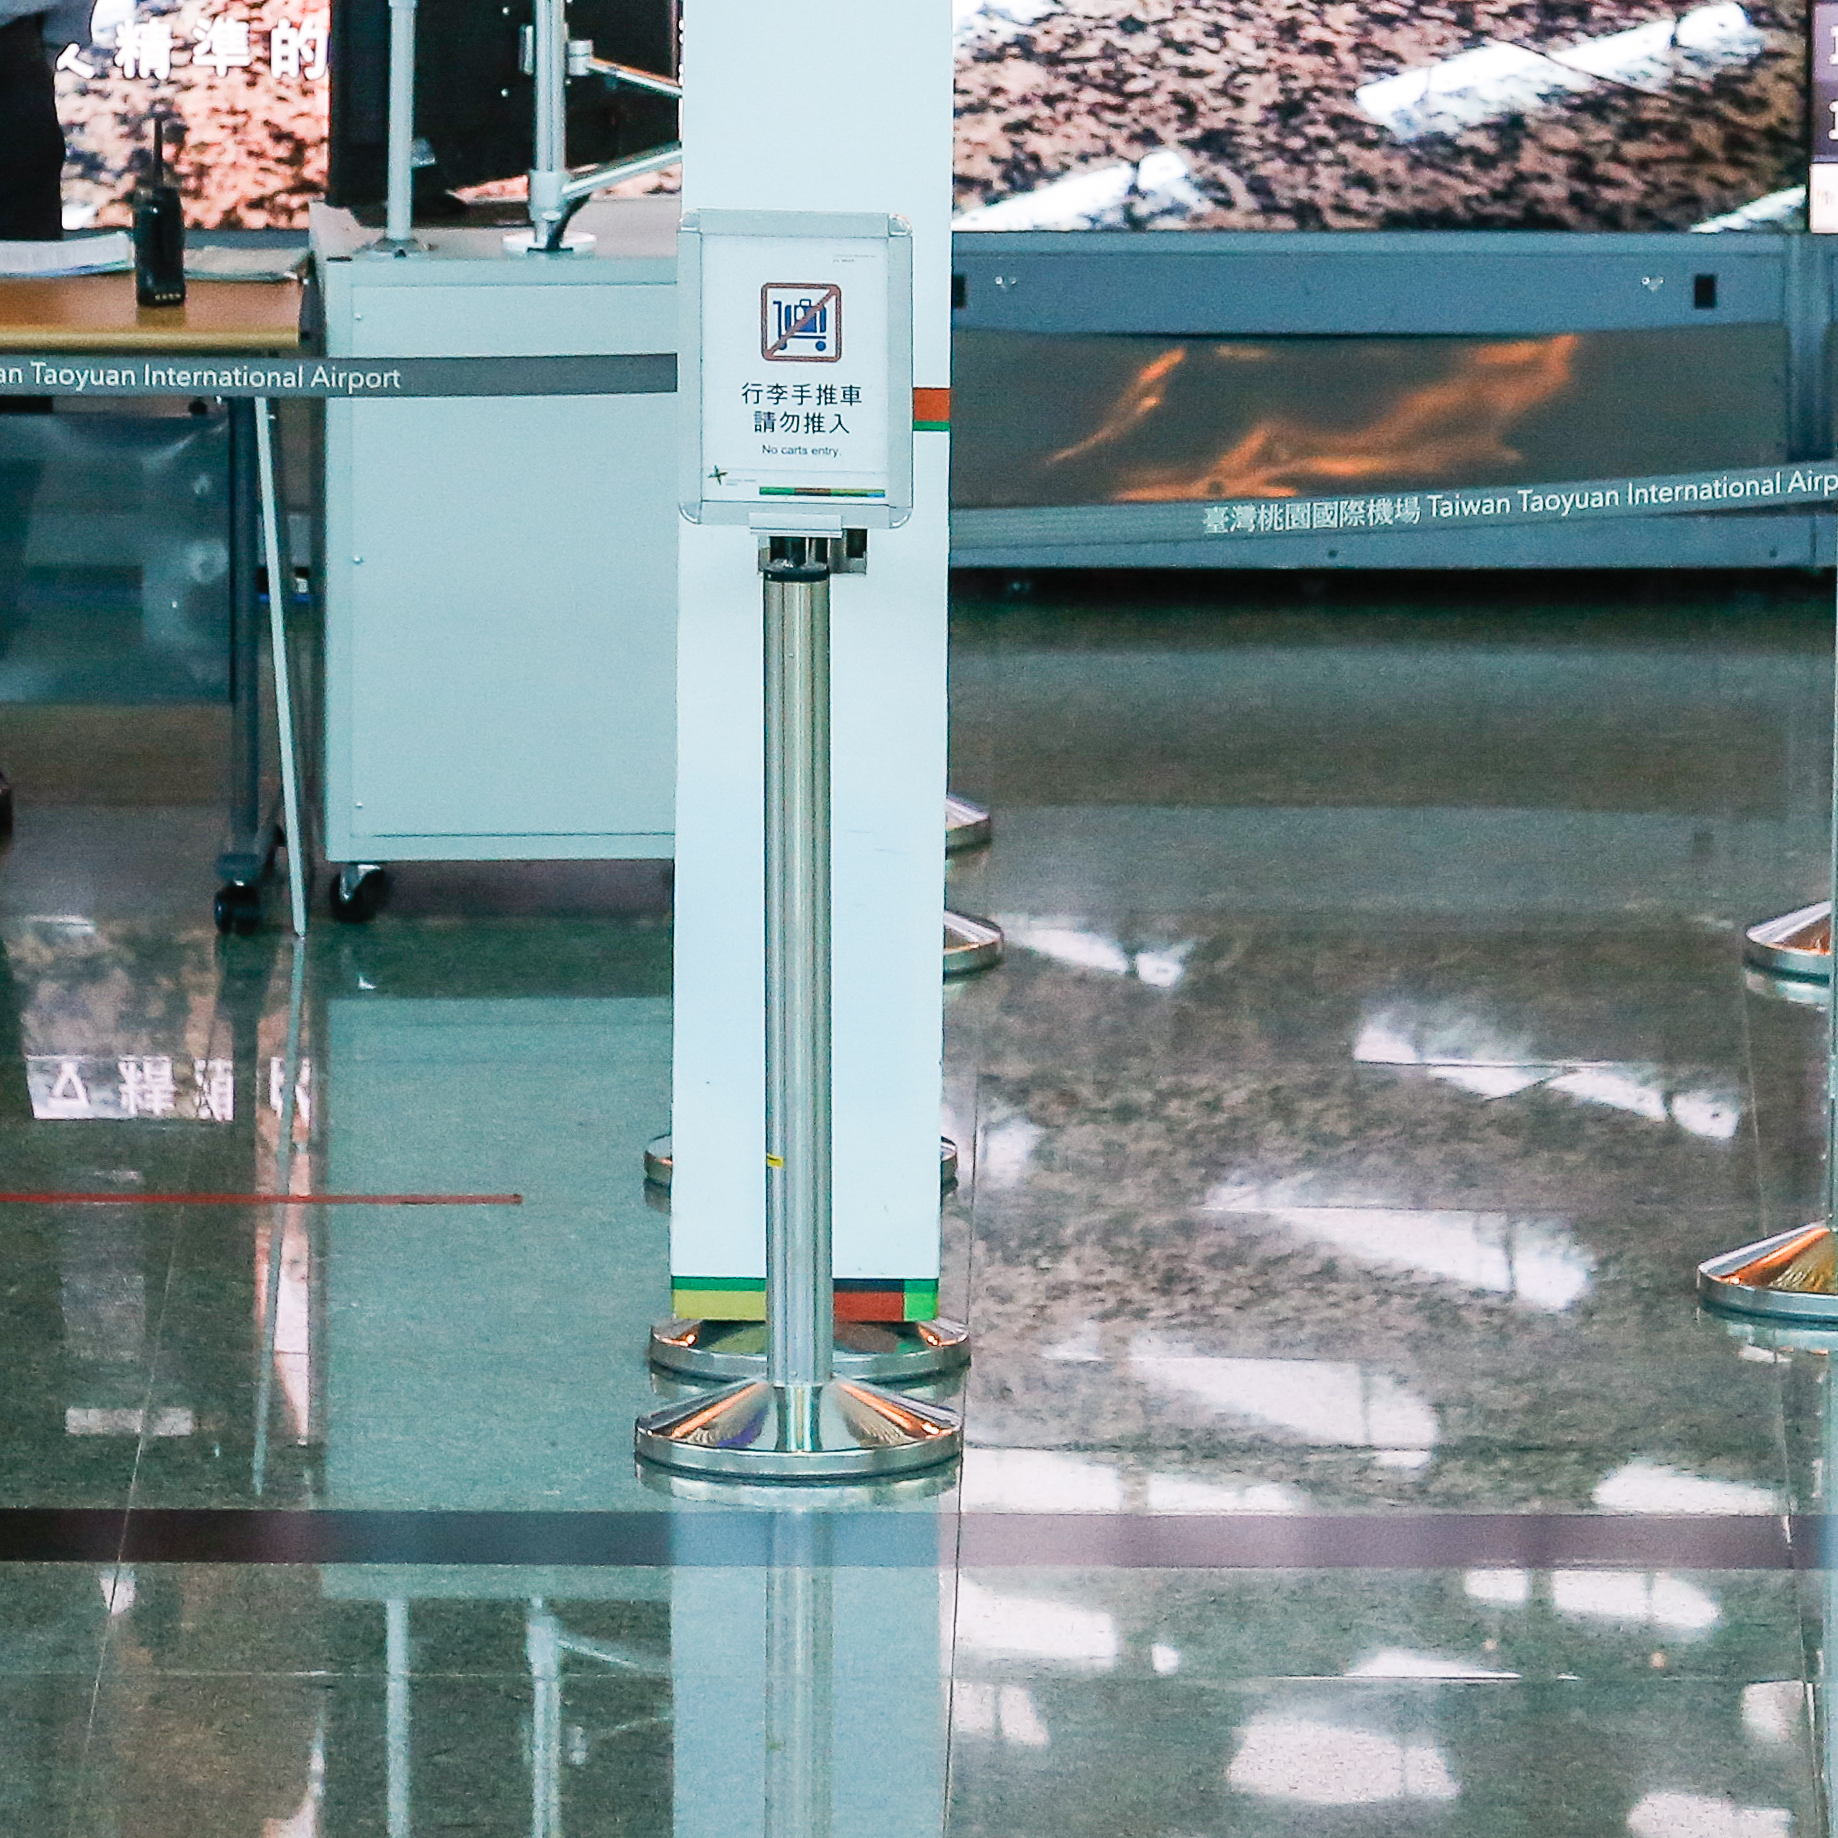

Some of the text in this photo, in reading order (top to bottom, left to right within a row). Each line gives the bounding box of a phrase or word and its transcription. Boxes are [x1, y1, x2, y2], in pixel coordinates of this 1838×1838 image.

[30, 361, 138, 394] Taoyuan
[143, 363, 305, 390] International
[310, 364, 401, 394] Airport
[740, 382, 863, 407] 行李手推車
[752, 410, 851, 435] 請勿推入
[761, 444, 843, 459] No carts entry.
[1428, 493, 1511, 517] Taiwan
[1517, 488, 1620, 517] Taoyuan
[1626, 473, 1782, 507] International
